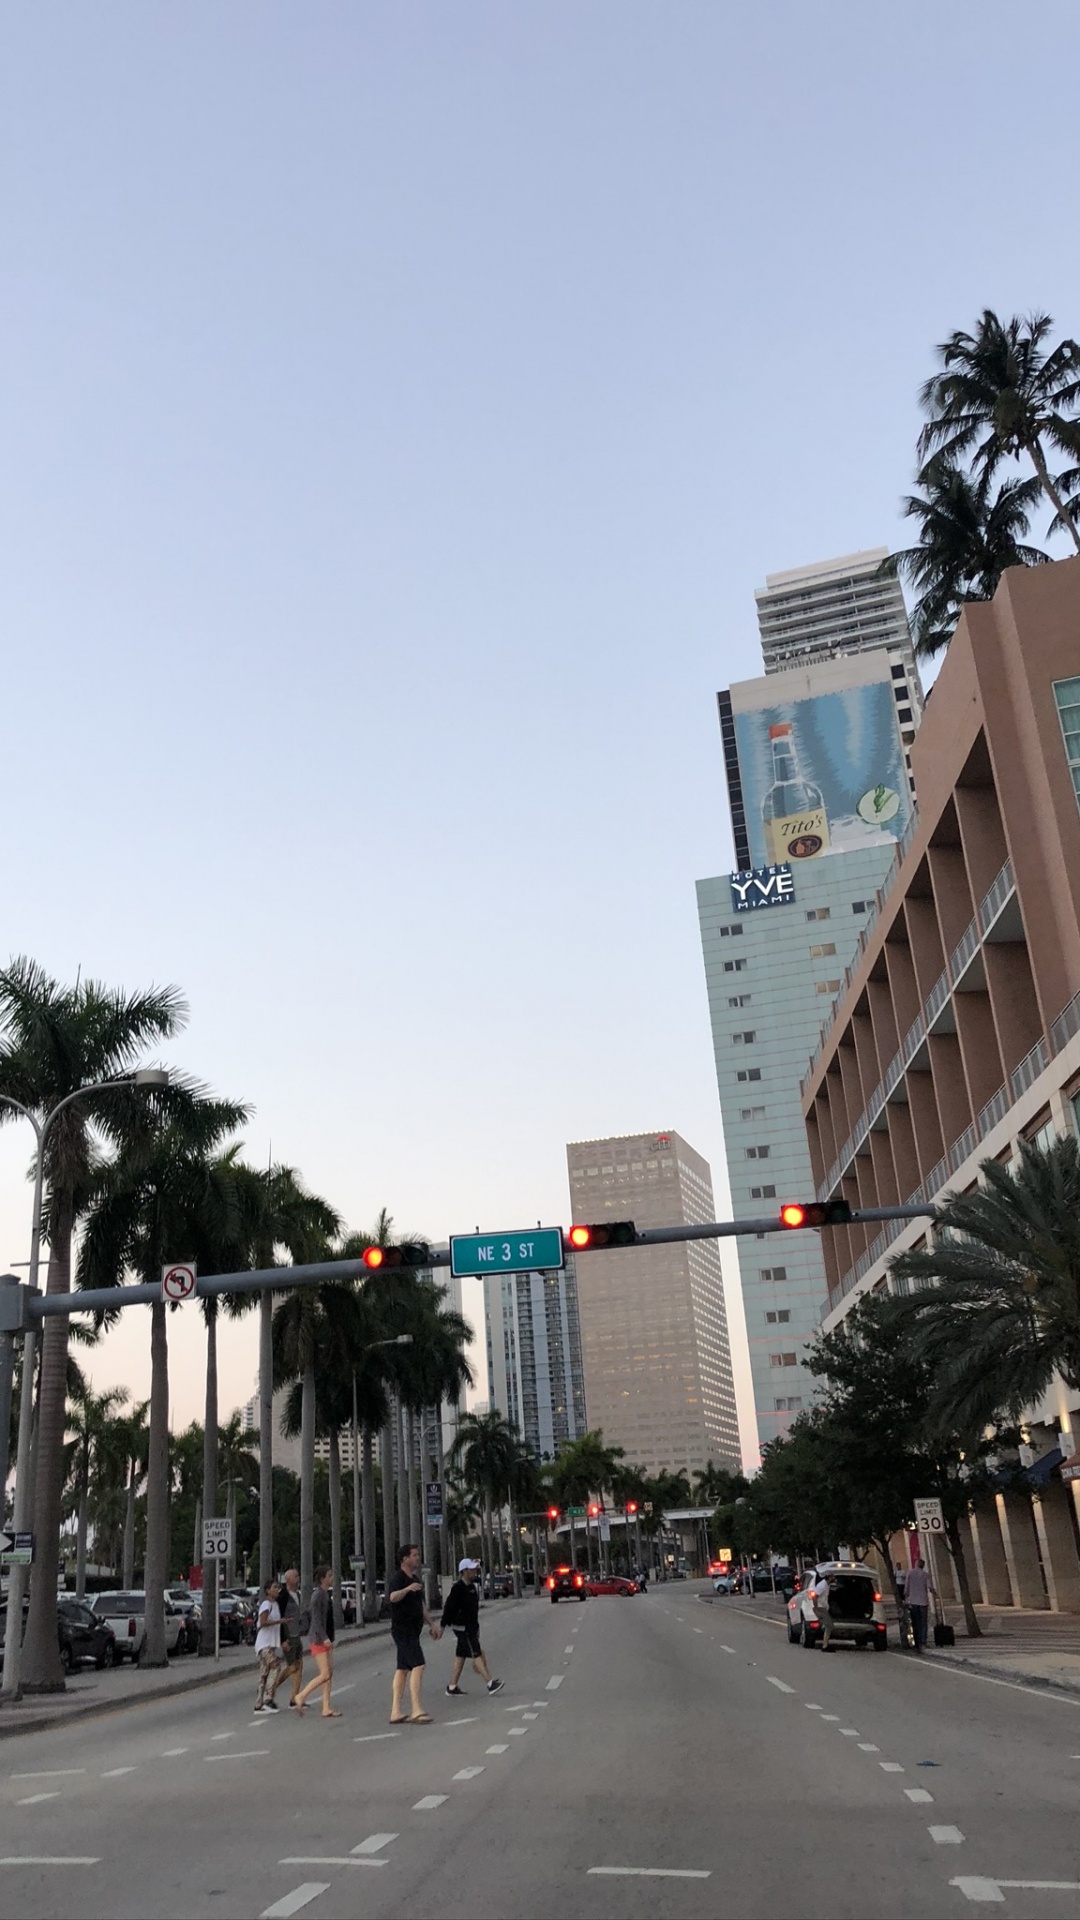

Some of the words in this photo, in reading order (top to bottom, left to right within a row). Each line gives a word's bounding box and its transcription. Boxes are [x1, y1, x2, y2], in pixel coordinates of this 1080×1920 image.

[780, 814, 823, 836] Tito's
[732, 866, 788, 881] HOTEL
[731, 873, 794, 900] YVE
[737, 894, 790, 909] MIAMI
[478, 1246, 495, 1262] NE
[501, 1243, 512, 1261] 3
[519, 1242, 535, 1258] ST
[921, 1517, 941, 1530] 30
[207, 1530, 227, 1538] LIMIT
[205, 1539, 228, 1554] 30
